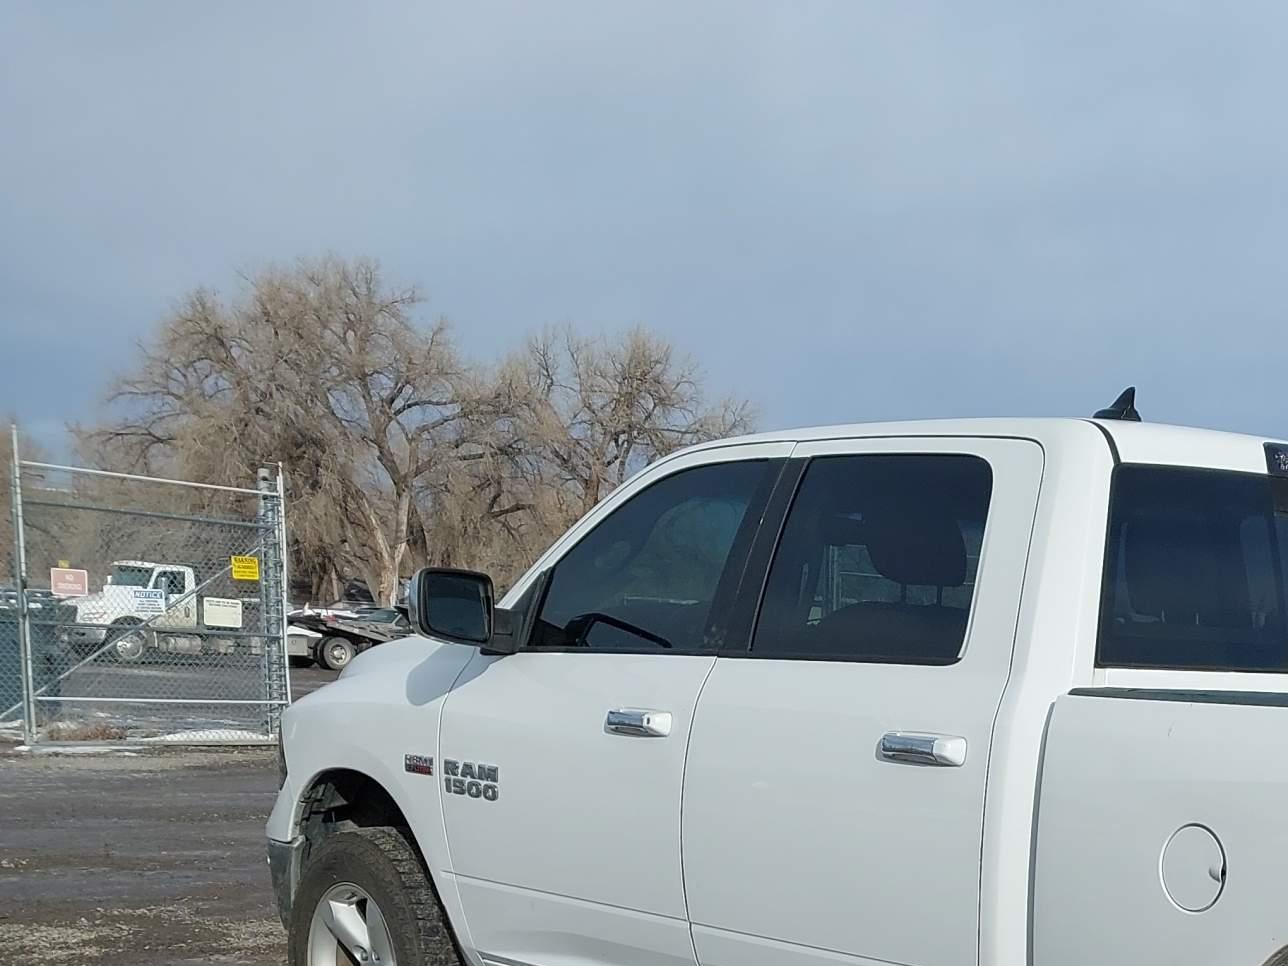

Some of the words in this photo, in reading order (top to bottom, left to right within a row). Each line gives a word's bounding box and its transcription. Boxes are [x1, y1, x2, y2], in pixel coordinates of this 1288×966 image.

[135, 591, 162, 599] NOTICE
[444, 759, 498, 783] RAM
[445, 777, 499, 801] 1500
